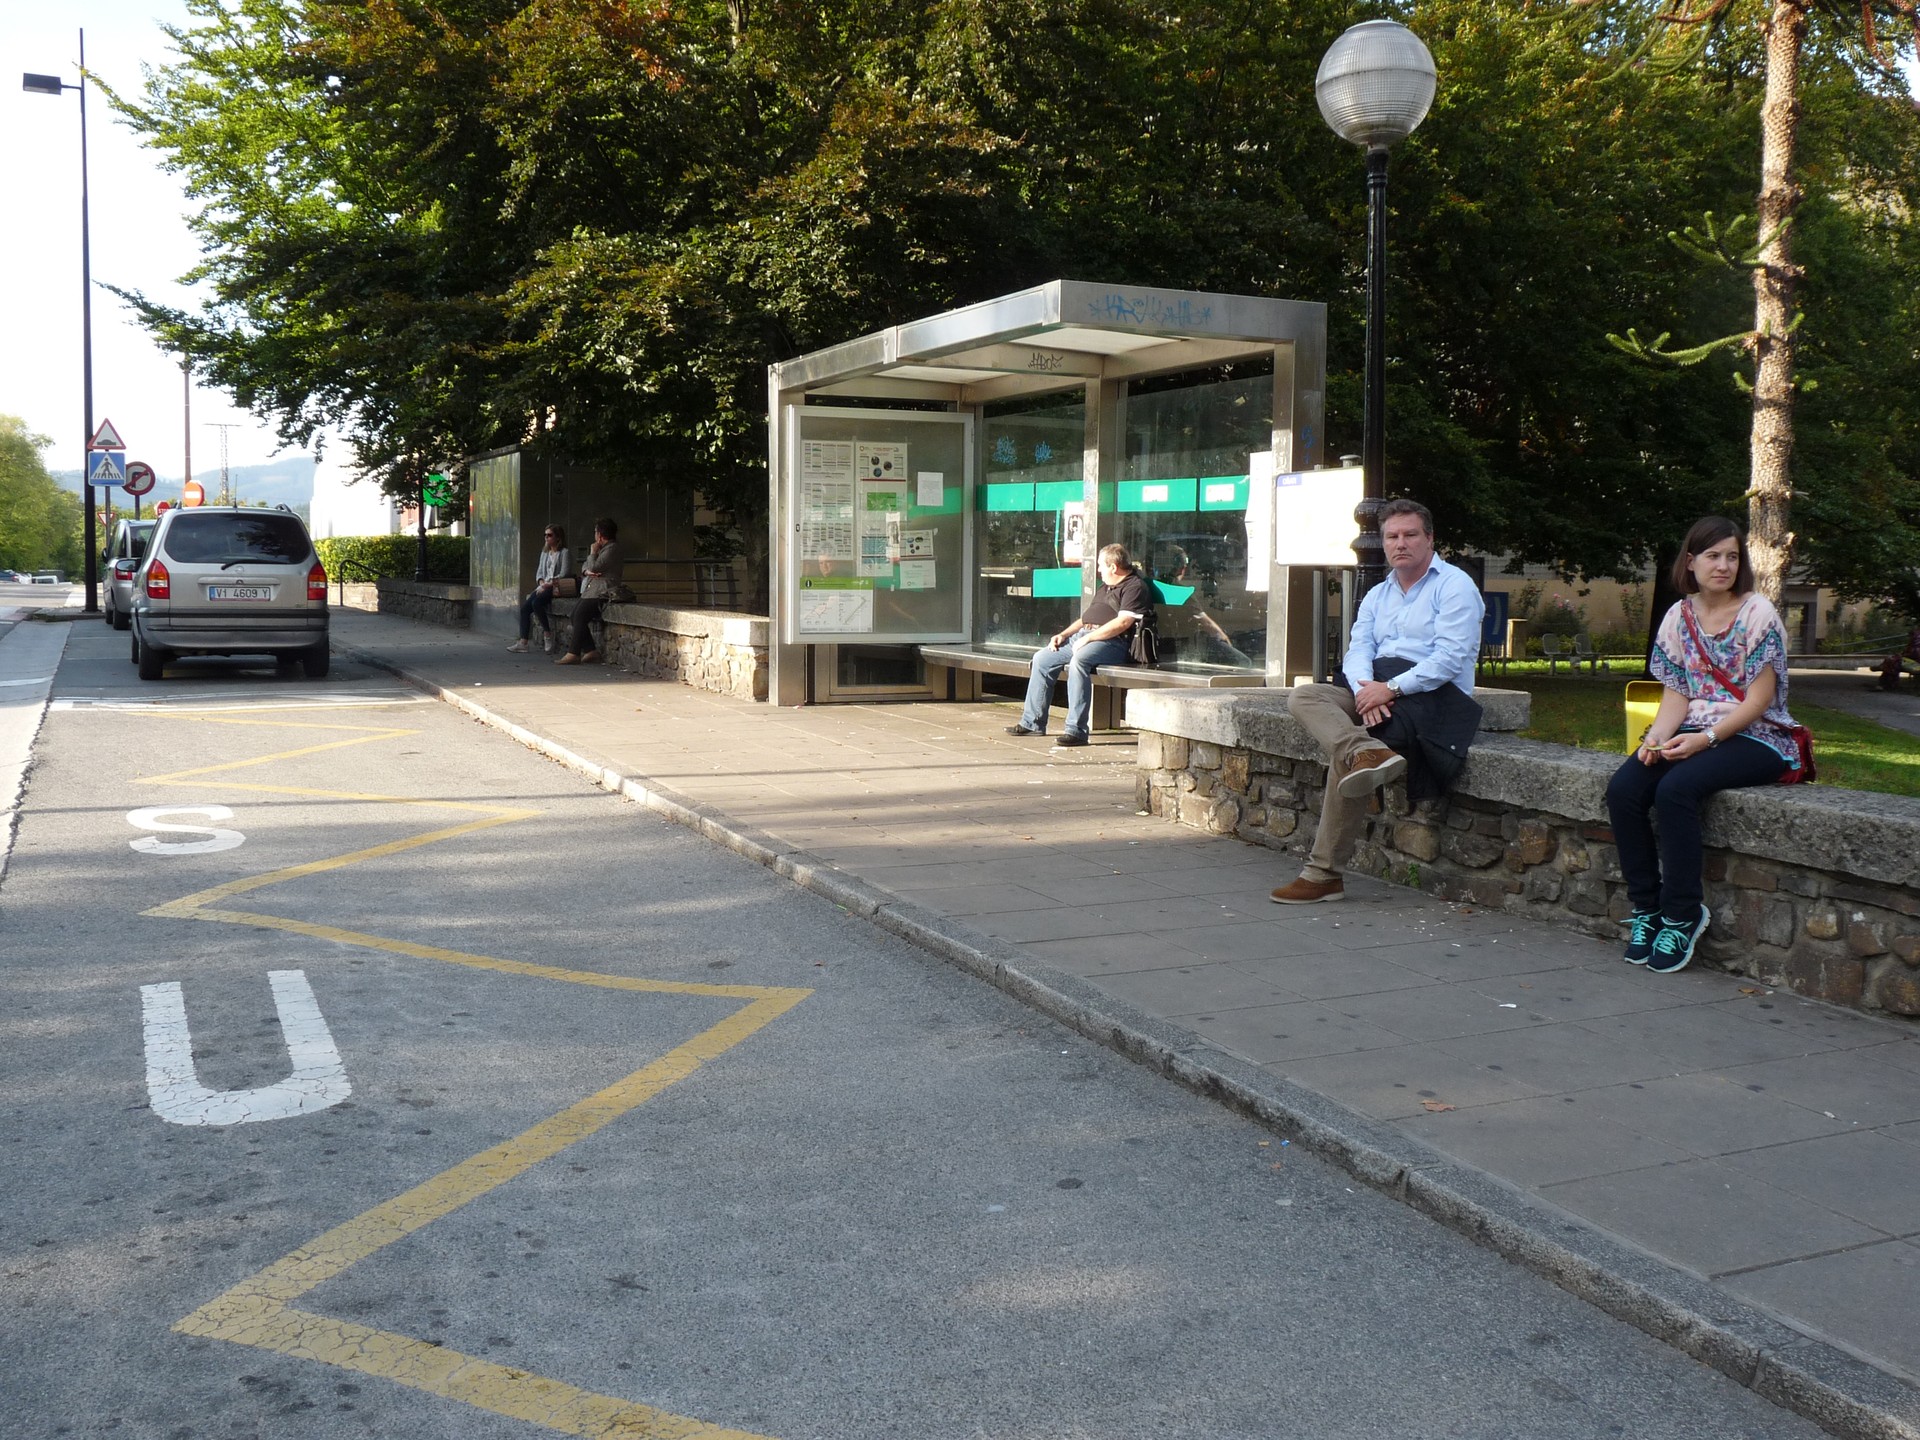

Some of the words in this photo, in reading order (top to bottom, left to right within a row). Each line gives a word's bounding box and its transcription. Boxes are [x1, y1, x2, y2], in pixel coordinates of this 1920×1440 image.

[233, 588, 258, 598] 4609
[262, 588, 268, 598] Y
[126, 803, 246, 855] S
[139, 970, 352, 1126] U
